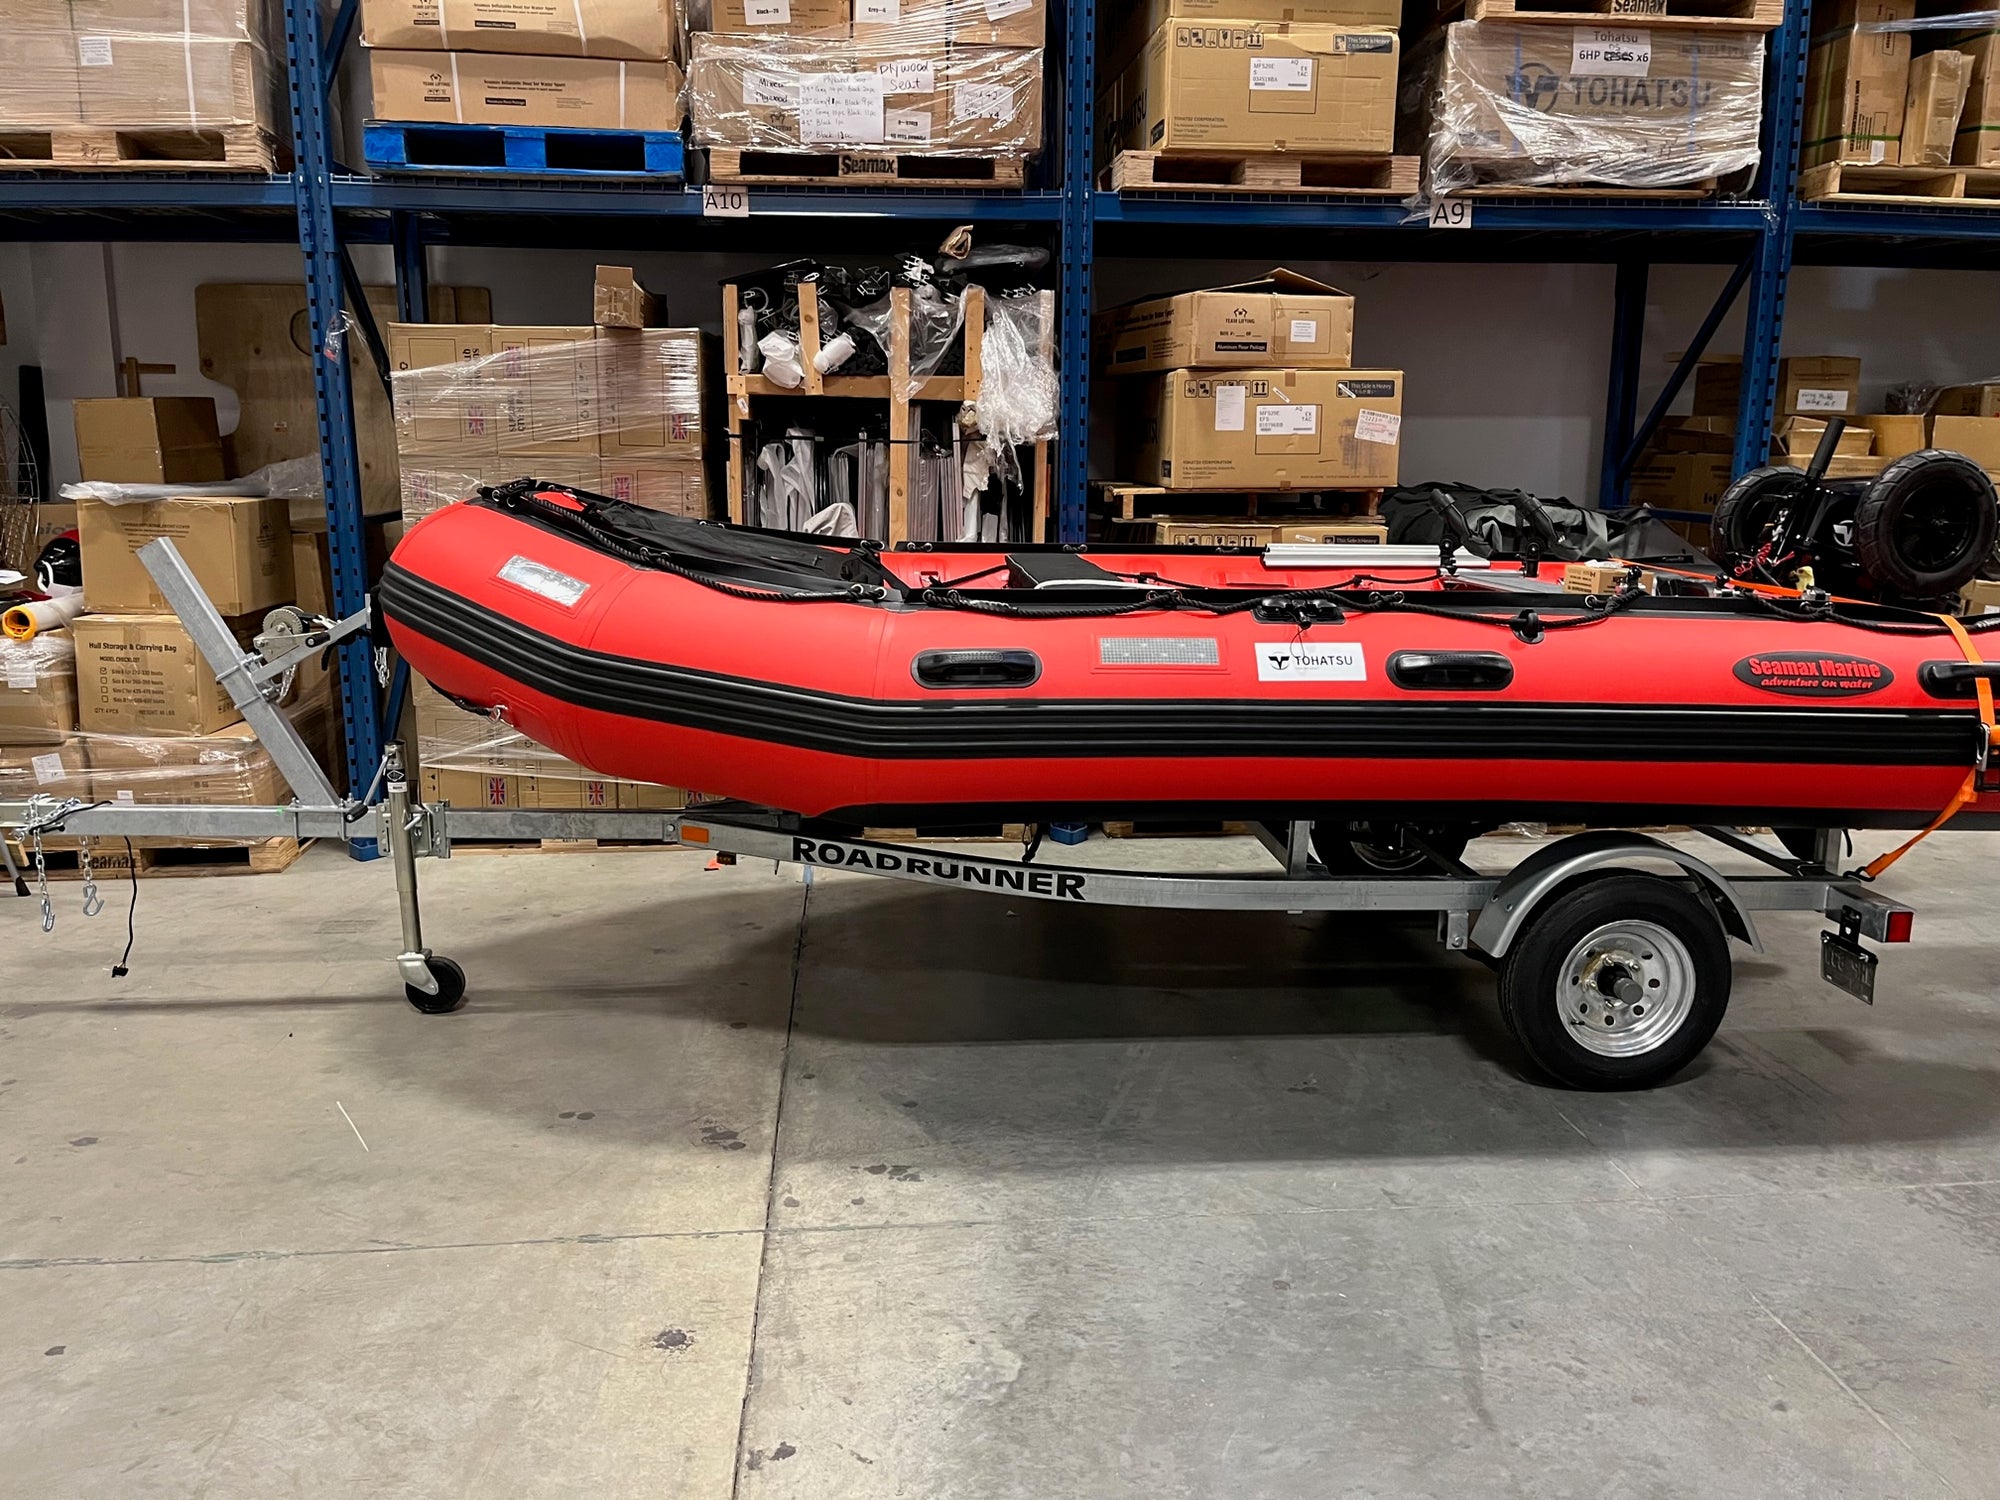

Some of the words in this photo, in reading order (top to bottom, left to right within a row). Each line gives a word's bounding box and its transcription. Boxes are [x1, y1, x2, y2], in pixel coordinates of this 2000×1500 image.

[1594, 31, 1638, 43] Tohatsu
[1579, 50, 1600, 60] 6HP
[1636, 53, 1649, 62] x6
[890, 78, 920, 92] Seat
[1570, 77, 1712, 108] TOHATSU
[842, 156, 895, 175] Seamax
[705, 192, 742, 210] A10
[1433, 202, 1464, 224] A9
[102, 642, 128, 652] Storage
[136, 644, 162, 652] Carrying
[164, 645, 177, 653] Bag
[1295, 656, 1352, 666] TOHATSU
[1748, 657, 1819, 676] Seamax
[1819, 660, 1881, 678] Marine
[1761, 676, 1819, 688] adventure
[1839, 680, 1873, 690] water
[792, 836, 1086, 900] ROADRUNNER
